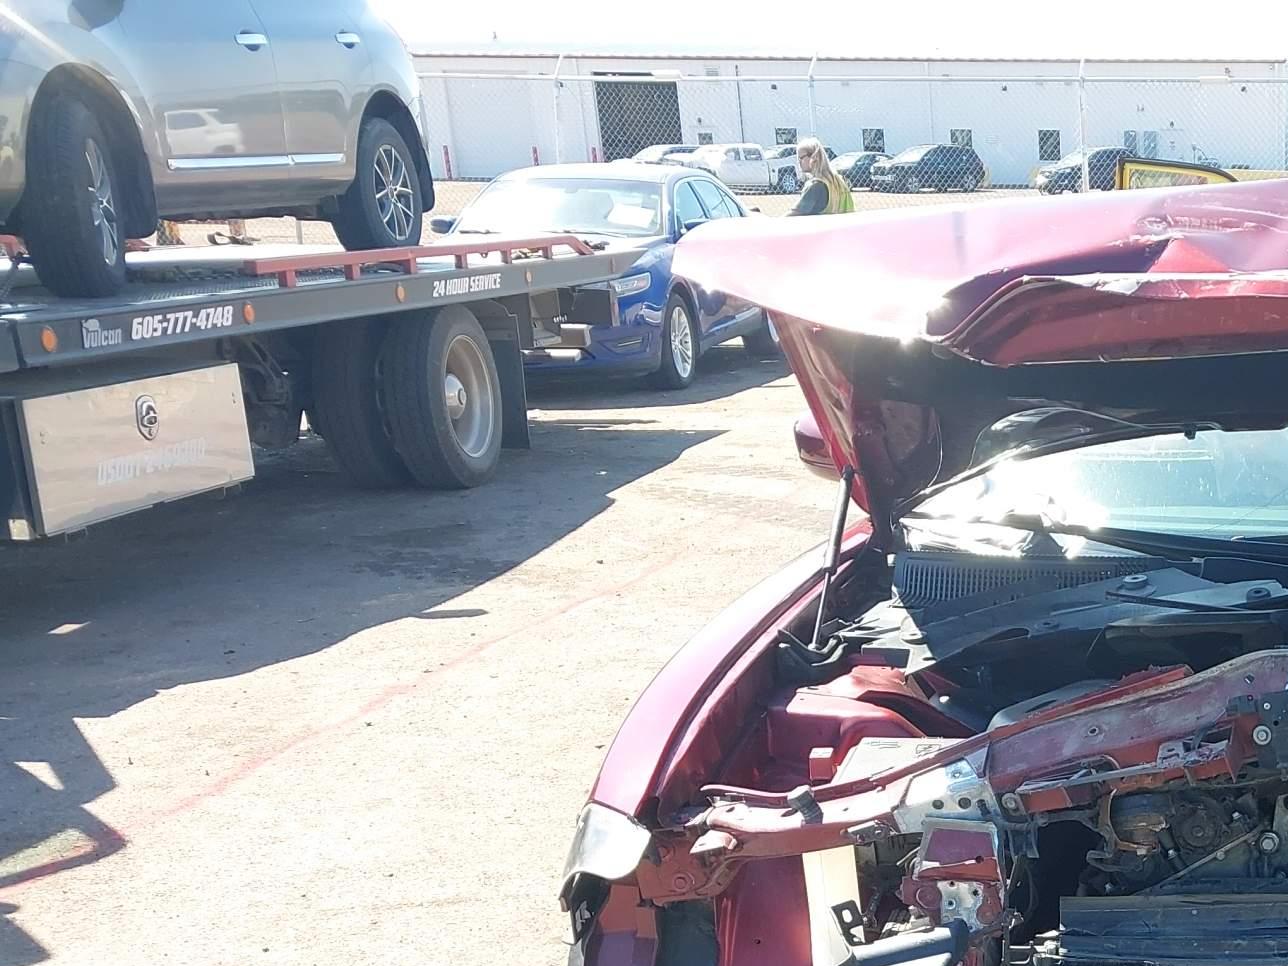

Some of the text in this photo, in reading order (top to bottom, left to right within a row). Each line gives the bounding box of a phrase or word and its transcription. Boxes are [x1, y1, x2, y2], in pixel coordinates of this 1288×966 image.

[432, 273, 501, 297] 24 HOUR SERVICE
[81, 320, 122, 349] Vulcan
[131, 305, 233, 340] 605-777-4748
